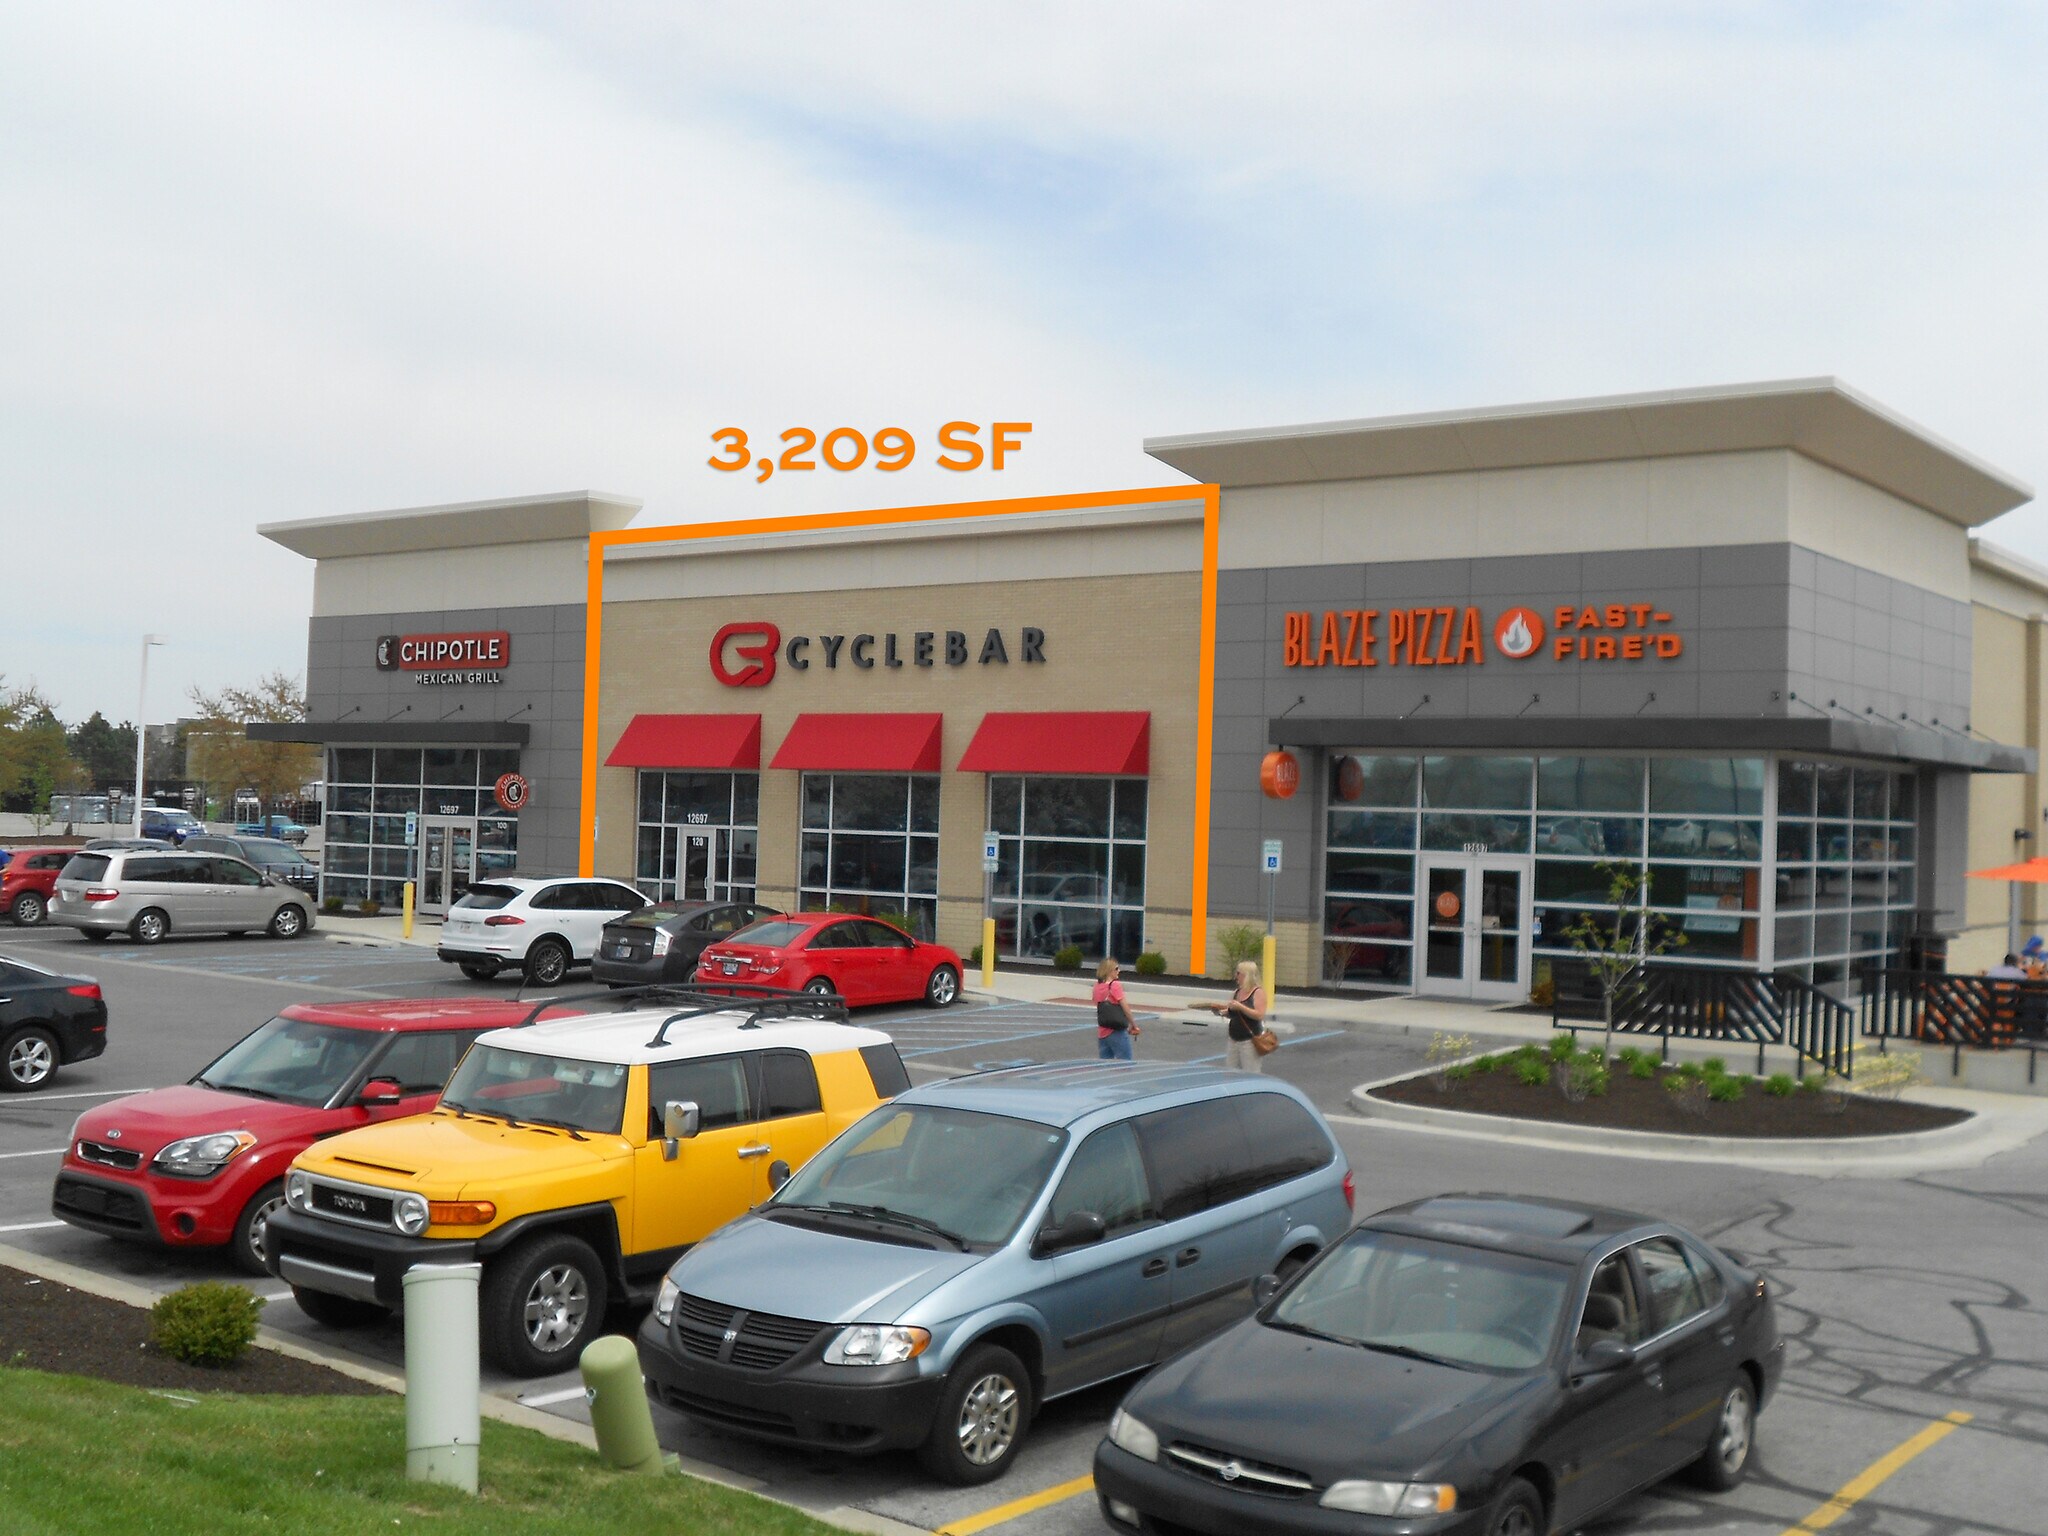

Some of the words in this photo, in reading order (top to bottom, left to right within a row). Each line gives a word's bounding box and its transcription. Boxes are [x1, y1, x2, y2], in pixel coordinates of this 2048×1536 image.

[1554, 602, 1673, 629] FAST-
[1284, 610, 1380, 667] BLAZE
[1388, 606, 1485, 666] PIZZA
[401, 639, 500, 662] CHIPOTLE
[786, 626, 1047, 671] CYCLEBAR
[1554, 633, 1682, 661] FIRE'D
[415, 673, 462, 685] MEXICAN
[467, 672, 500, 684] GRILL
[501, 774, 528, 790] CHIPOTLE
[440, 805, 459, 815] 12697
[497, 821, 507, 830] 100
[687, 813, 708, 824] 12697
[692, 837, 704, 846] 120
[333, 1195, 365, 1211] TOYOTA
